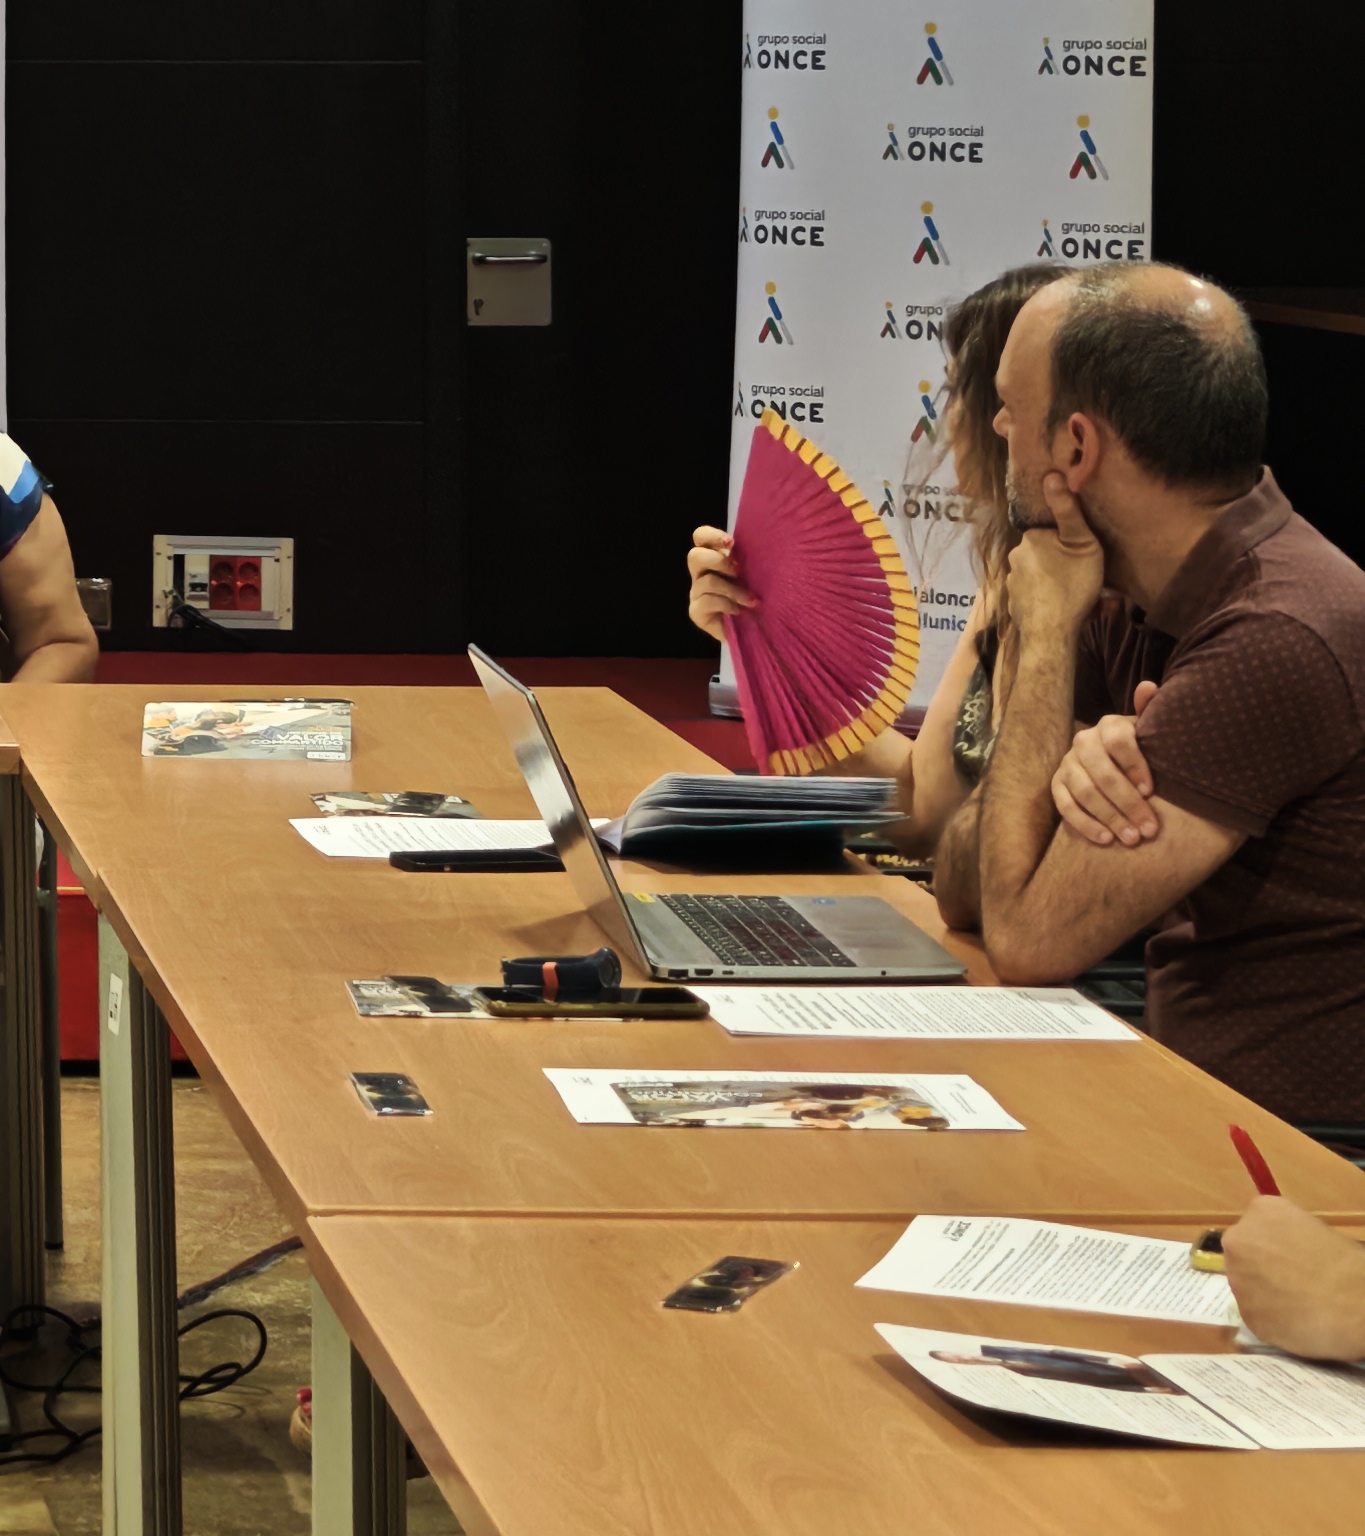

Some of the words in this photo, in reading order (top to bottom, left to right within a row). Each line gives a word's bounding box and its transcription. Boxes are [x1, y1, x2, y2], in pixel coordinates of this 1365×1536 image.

[758, 35, 789, 46] grupo
[792, 32, 826, 44] social
[1063, 39, 1102, 52] grupo
[1106, 37, 1147, 50] social
[757, 50, 826, 70] ONCE
[1063, 55, 1146, 76] ONCE
[908, 126, 946, 138] grupo
[948, 125, 983, 137] social
[908, 141, 983, 163] ONCE
[755, 209, 787, 221] grupo
[790, 209, 825, 221] social
[754, 225, 824, 246] ONCE
[1062, 222, 1100, 234] grupo
[1104, 221, 1144, 234] social
[1062, 238, 1144, 260] ONCE
[906, 304, 943, 317] grupo
[906, 320, 943, 341] ON
[751, 384, 785, 396] grupo
[789, 385, 824, 398] social
[751, 400, 824, 423] ONCE
